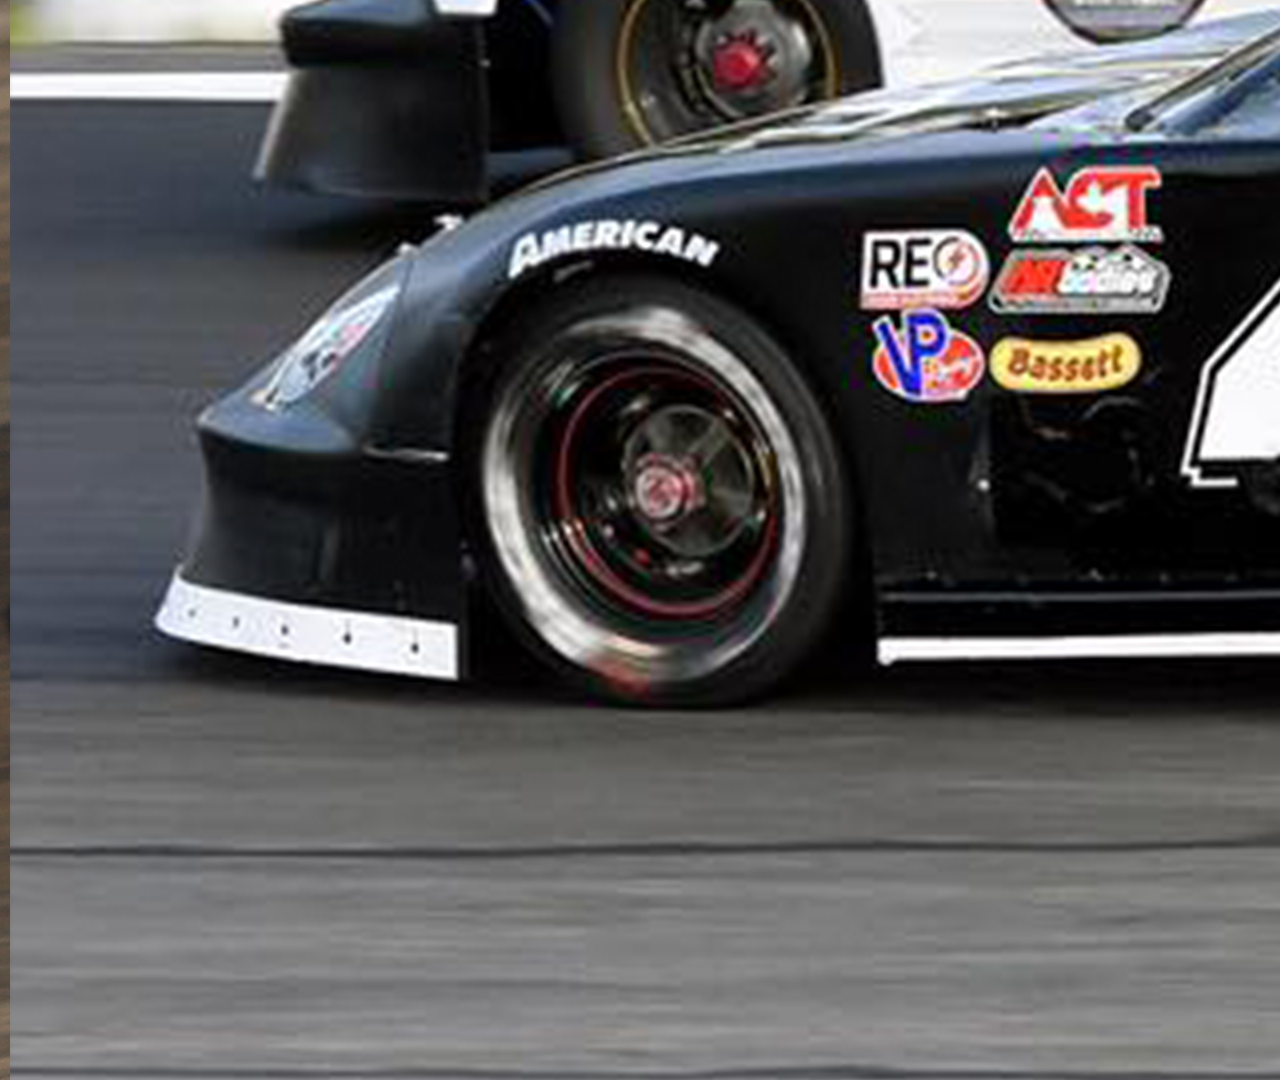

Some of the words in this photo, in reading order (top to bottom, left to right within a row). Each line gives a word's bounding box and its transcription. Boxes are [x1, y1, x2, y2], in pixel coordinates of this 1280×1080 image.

[1008, 167, 1162, 236] ACT
[507, 220, 720, 278] AMERICAN
[872, 310, 950, 398] VP
[1007, 343, 1125, 383] Bassett
